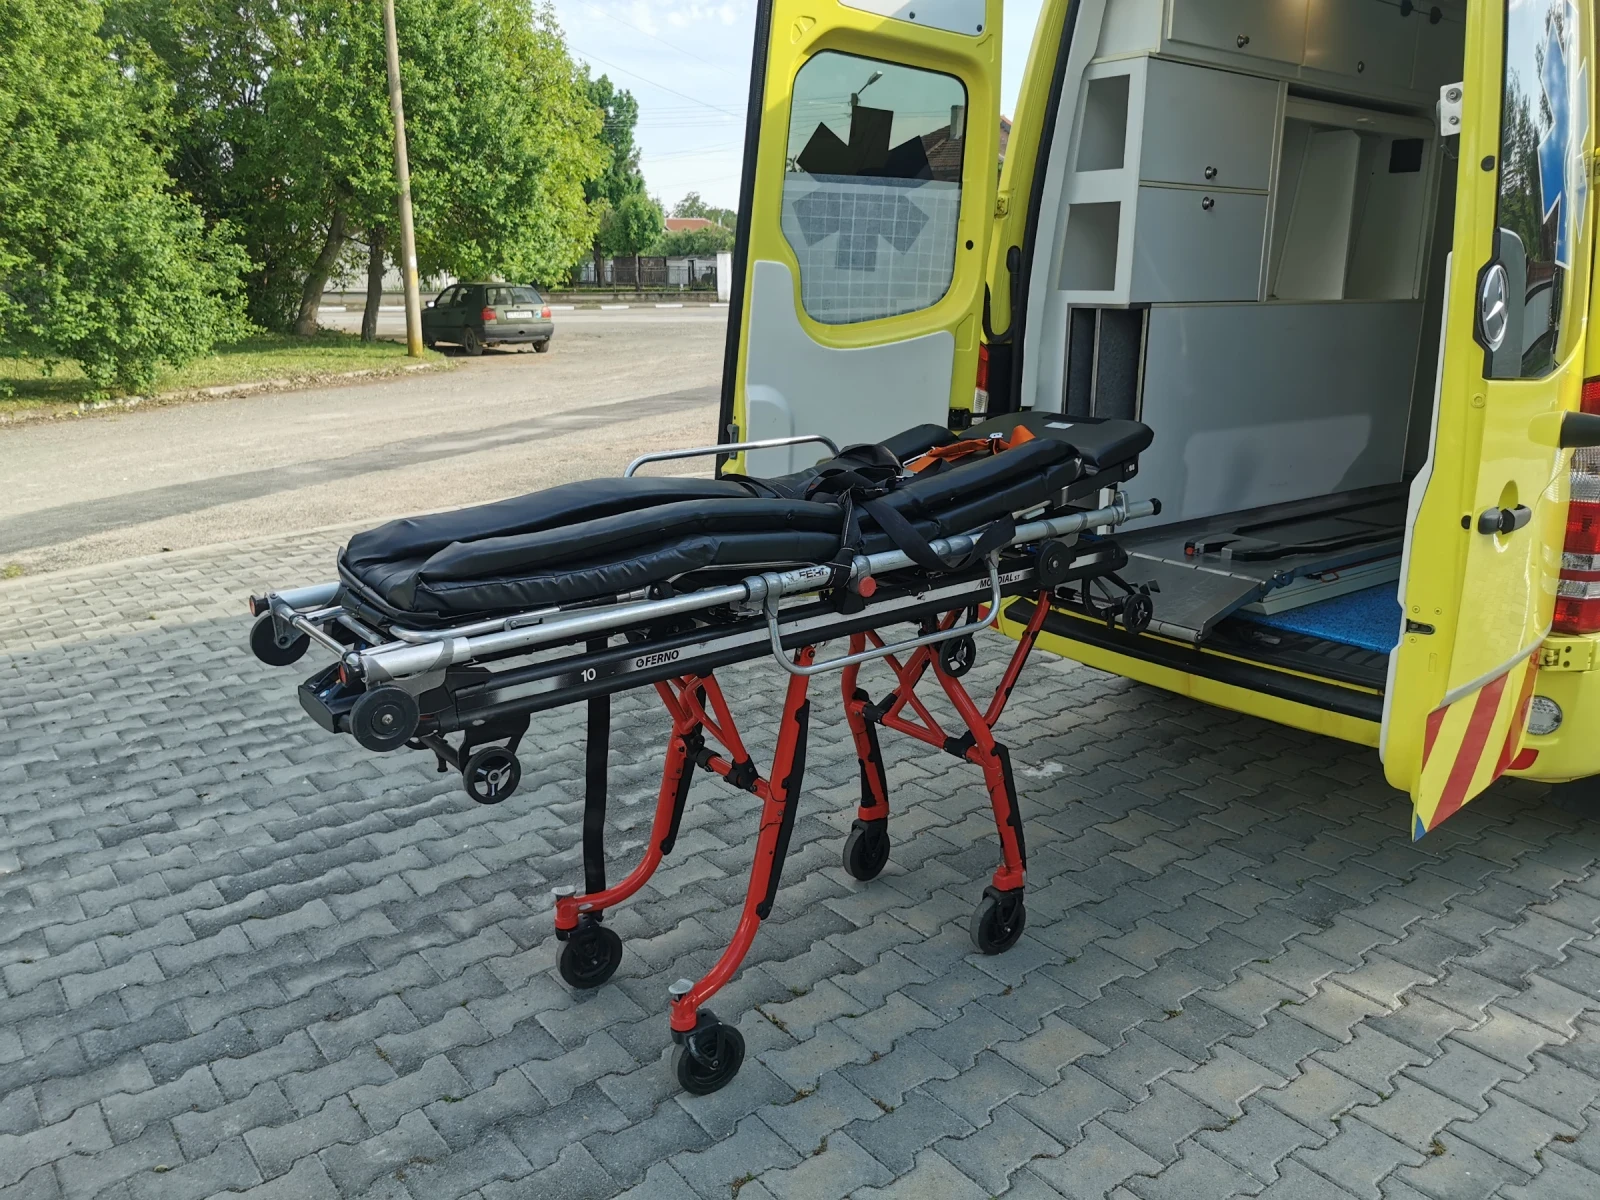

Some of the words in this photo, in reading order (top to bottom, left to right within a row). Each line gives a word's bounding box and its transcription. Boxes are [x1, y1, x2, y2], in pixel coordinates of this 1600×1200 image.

[980, 573, 1013, 588] MODIAL
[644, 650, 679, 667] FERNO
[580, 668, 597, 682] 10
